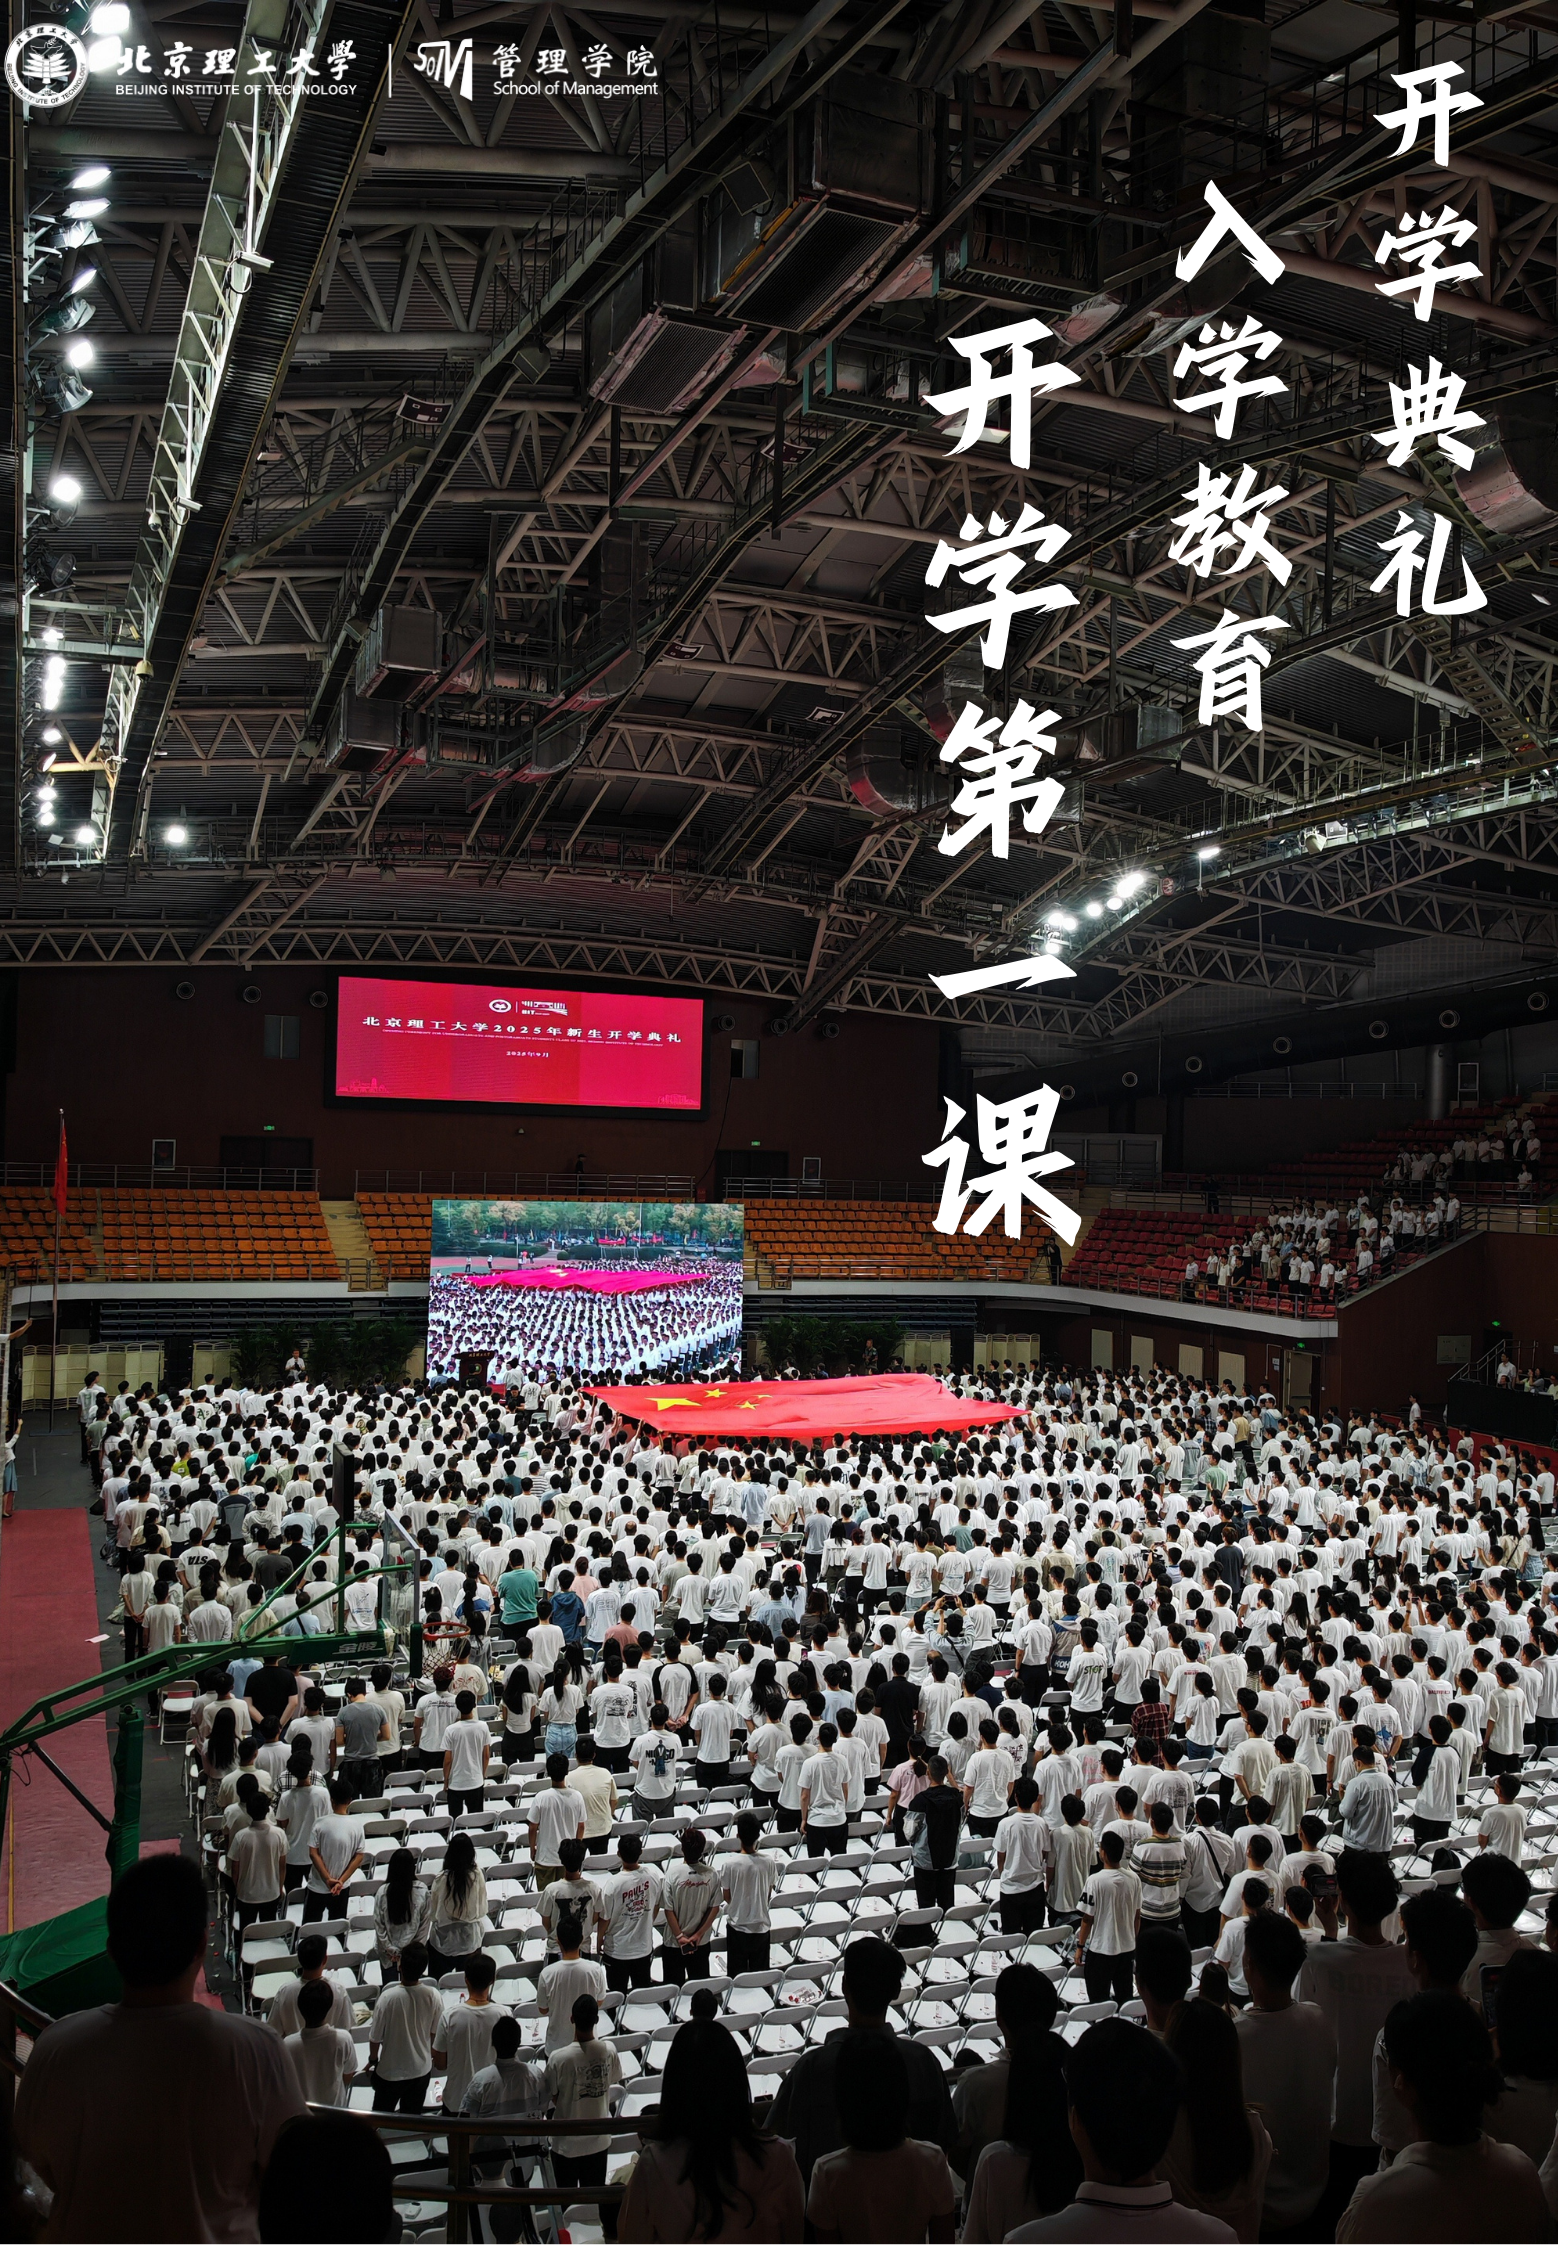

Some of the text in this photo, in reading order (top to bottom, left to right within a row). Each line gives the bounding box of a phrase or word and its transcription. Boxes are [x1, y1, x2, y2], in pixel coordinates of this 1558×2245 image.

[362, 1016, 682, 1043] 北京理工大学2025年新生开学典礼
[332, 1641, 384, 1655] 金陵
[622, 1880, 650, 1903] PAUL'S
